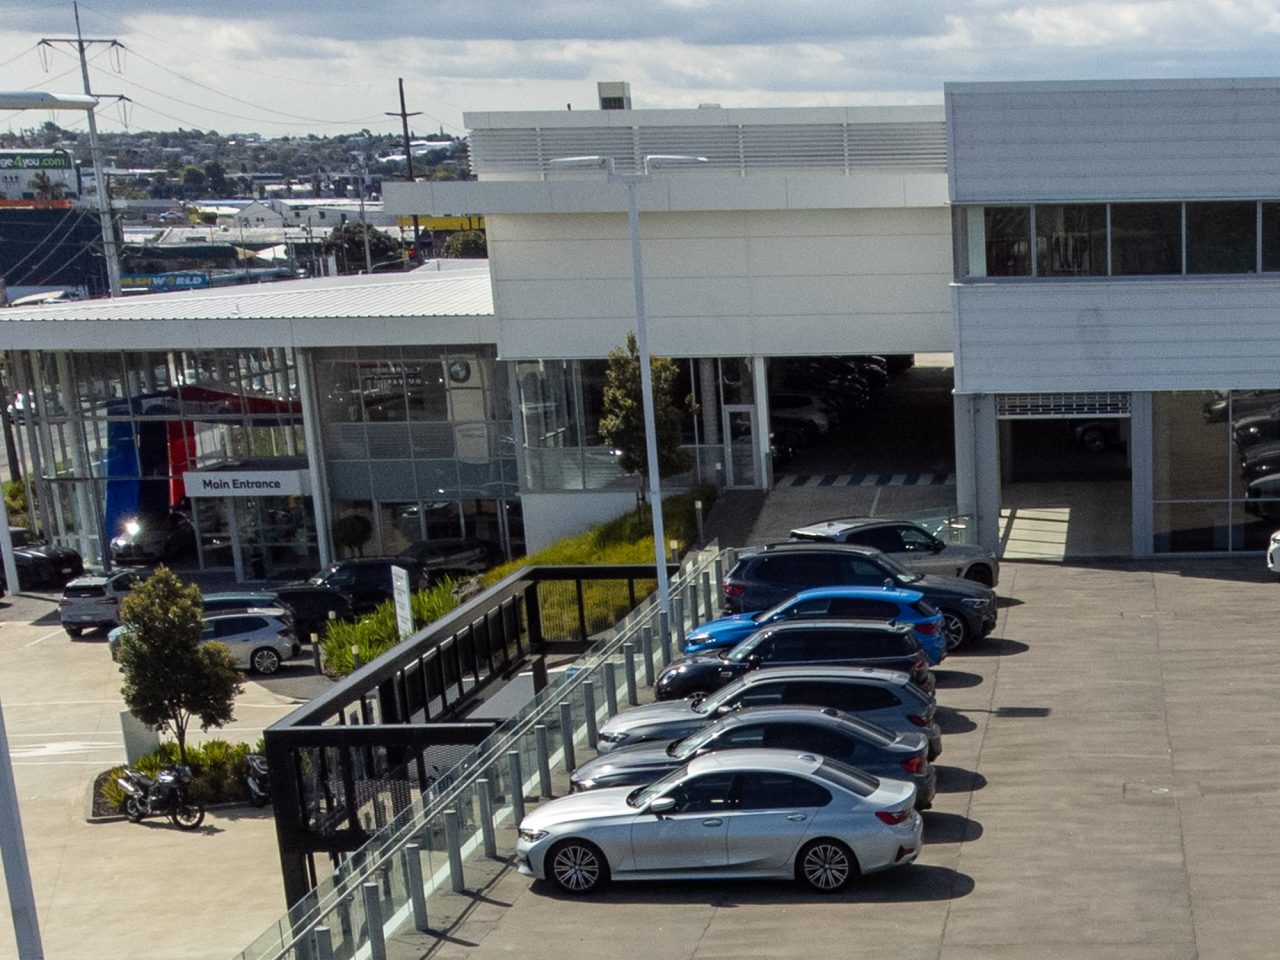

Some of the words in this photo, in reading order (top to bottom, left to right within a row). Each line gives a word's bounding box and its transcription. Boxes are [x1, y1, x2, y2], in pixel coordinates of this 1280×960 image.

[119, 275, 202, 286] ASHWORLD
[202, 479, 230, 490] Main
[232, 478, 281, 490] Entrance
